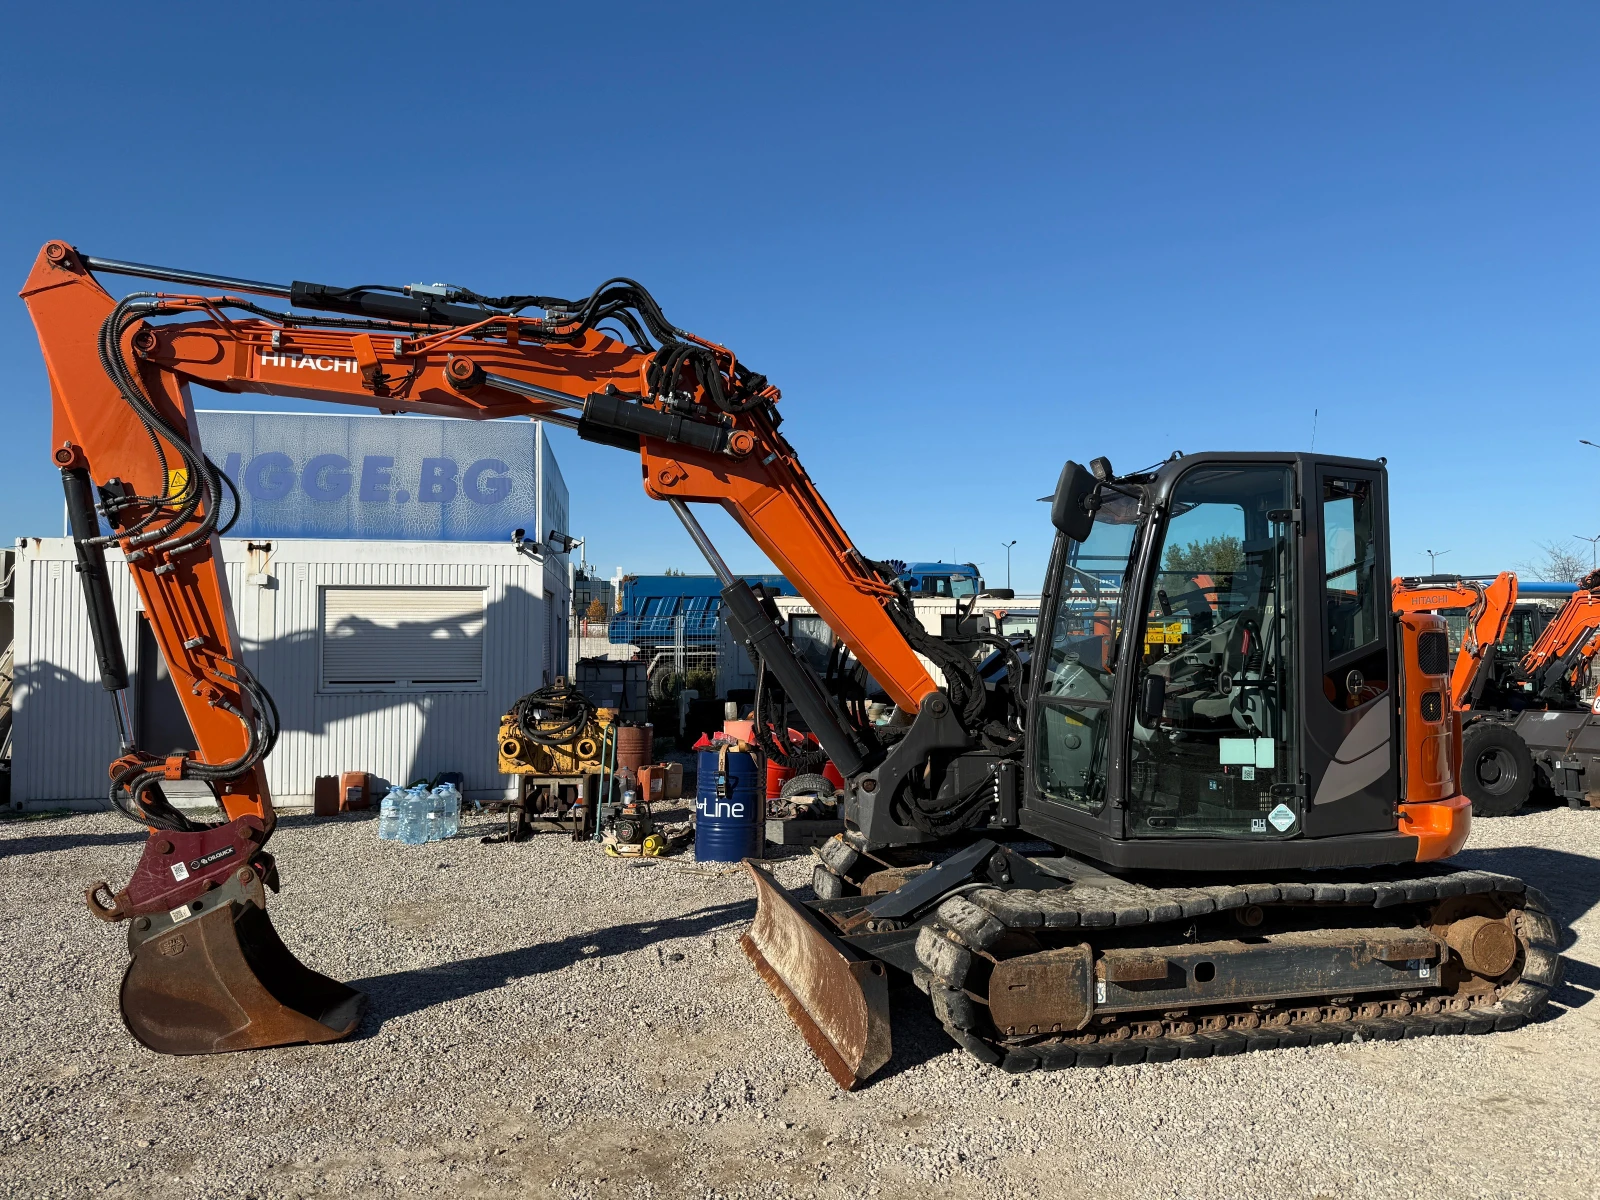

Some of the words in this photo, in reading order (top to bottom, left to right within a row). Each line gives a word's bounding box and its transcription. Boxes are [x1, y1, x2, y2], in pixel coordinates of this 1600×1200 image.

[261, 350, 358, 374] HITACHI
[220, 451, 512, 504] IGGE.BG
[1411, 594, 1448, 605] HITACHI
